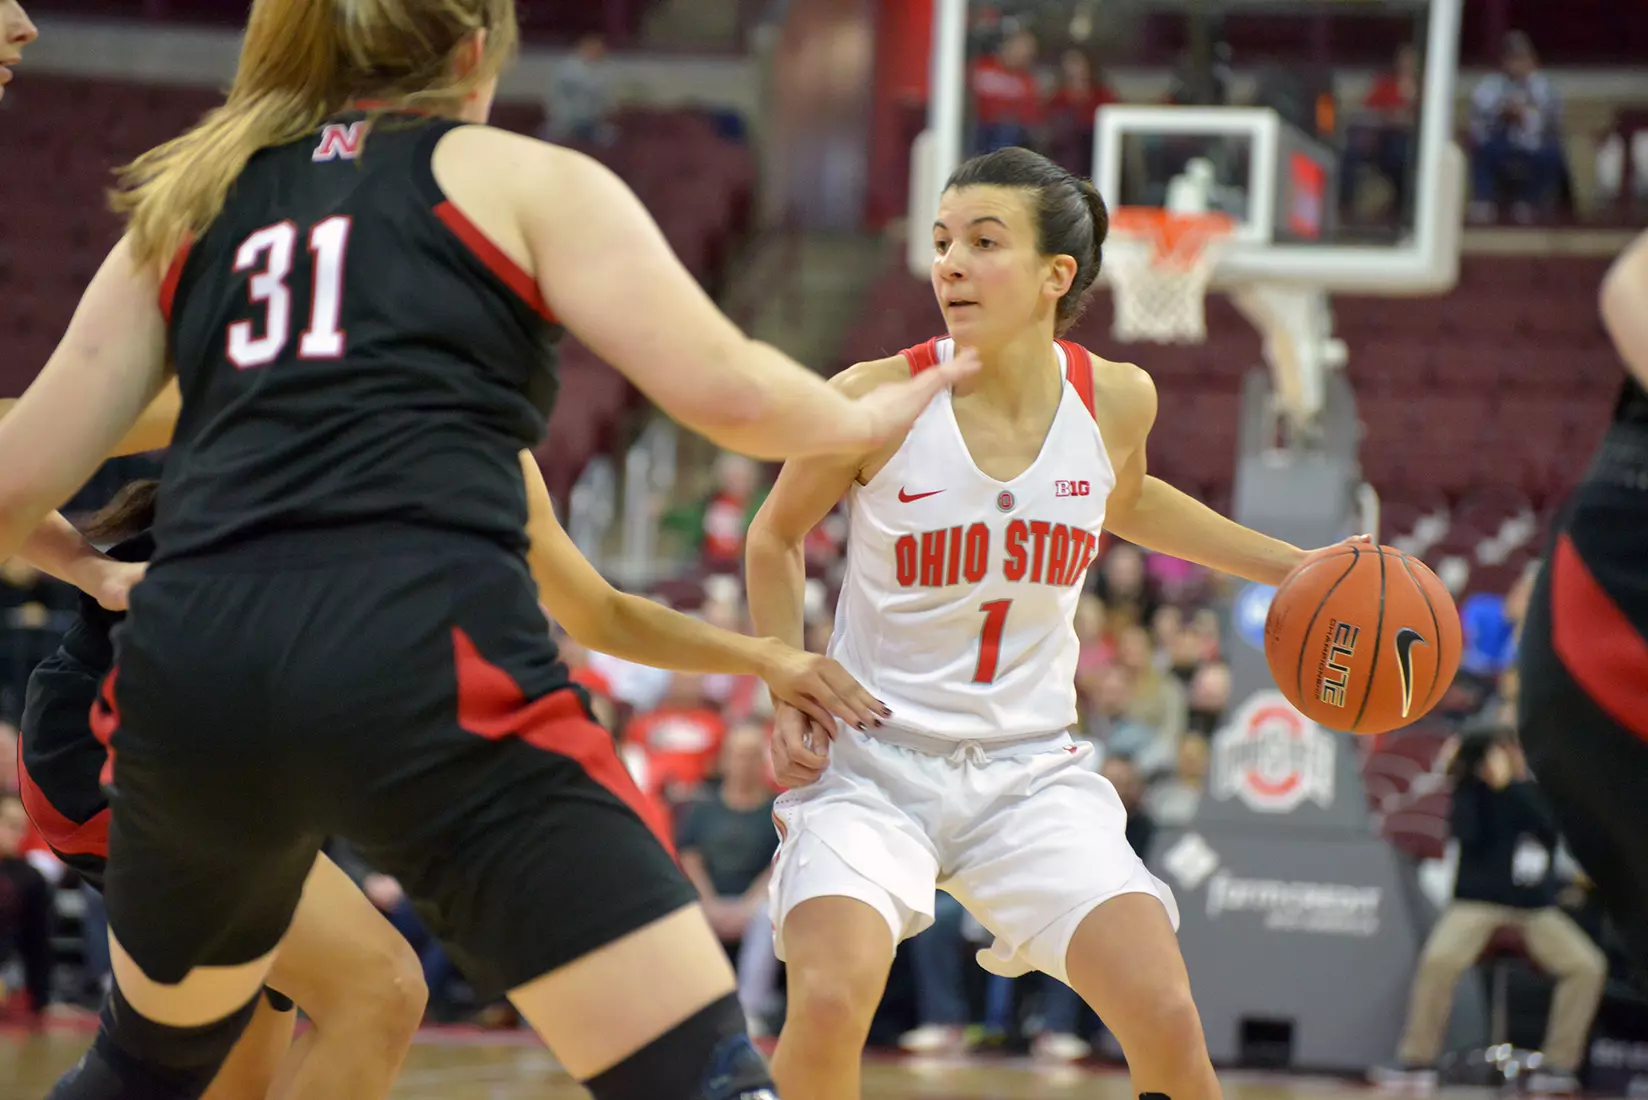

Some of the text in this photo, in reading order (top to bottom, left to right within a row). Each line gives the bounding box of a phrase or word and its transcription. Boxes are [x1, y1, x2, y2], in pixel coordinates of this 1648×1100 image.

[312, 121, 369, 161] N
[225, 214, 352, 370] 31
[895, 521, 990, 588] OHIO
[971, 597, 1014, 685] 1
[1321, 620, 1361, 708] ELITE
